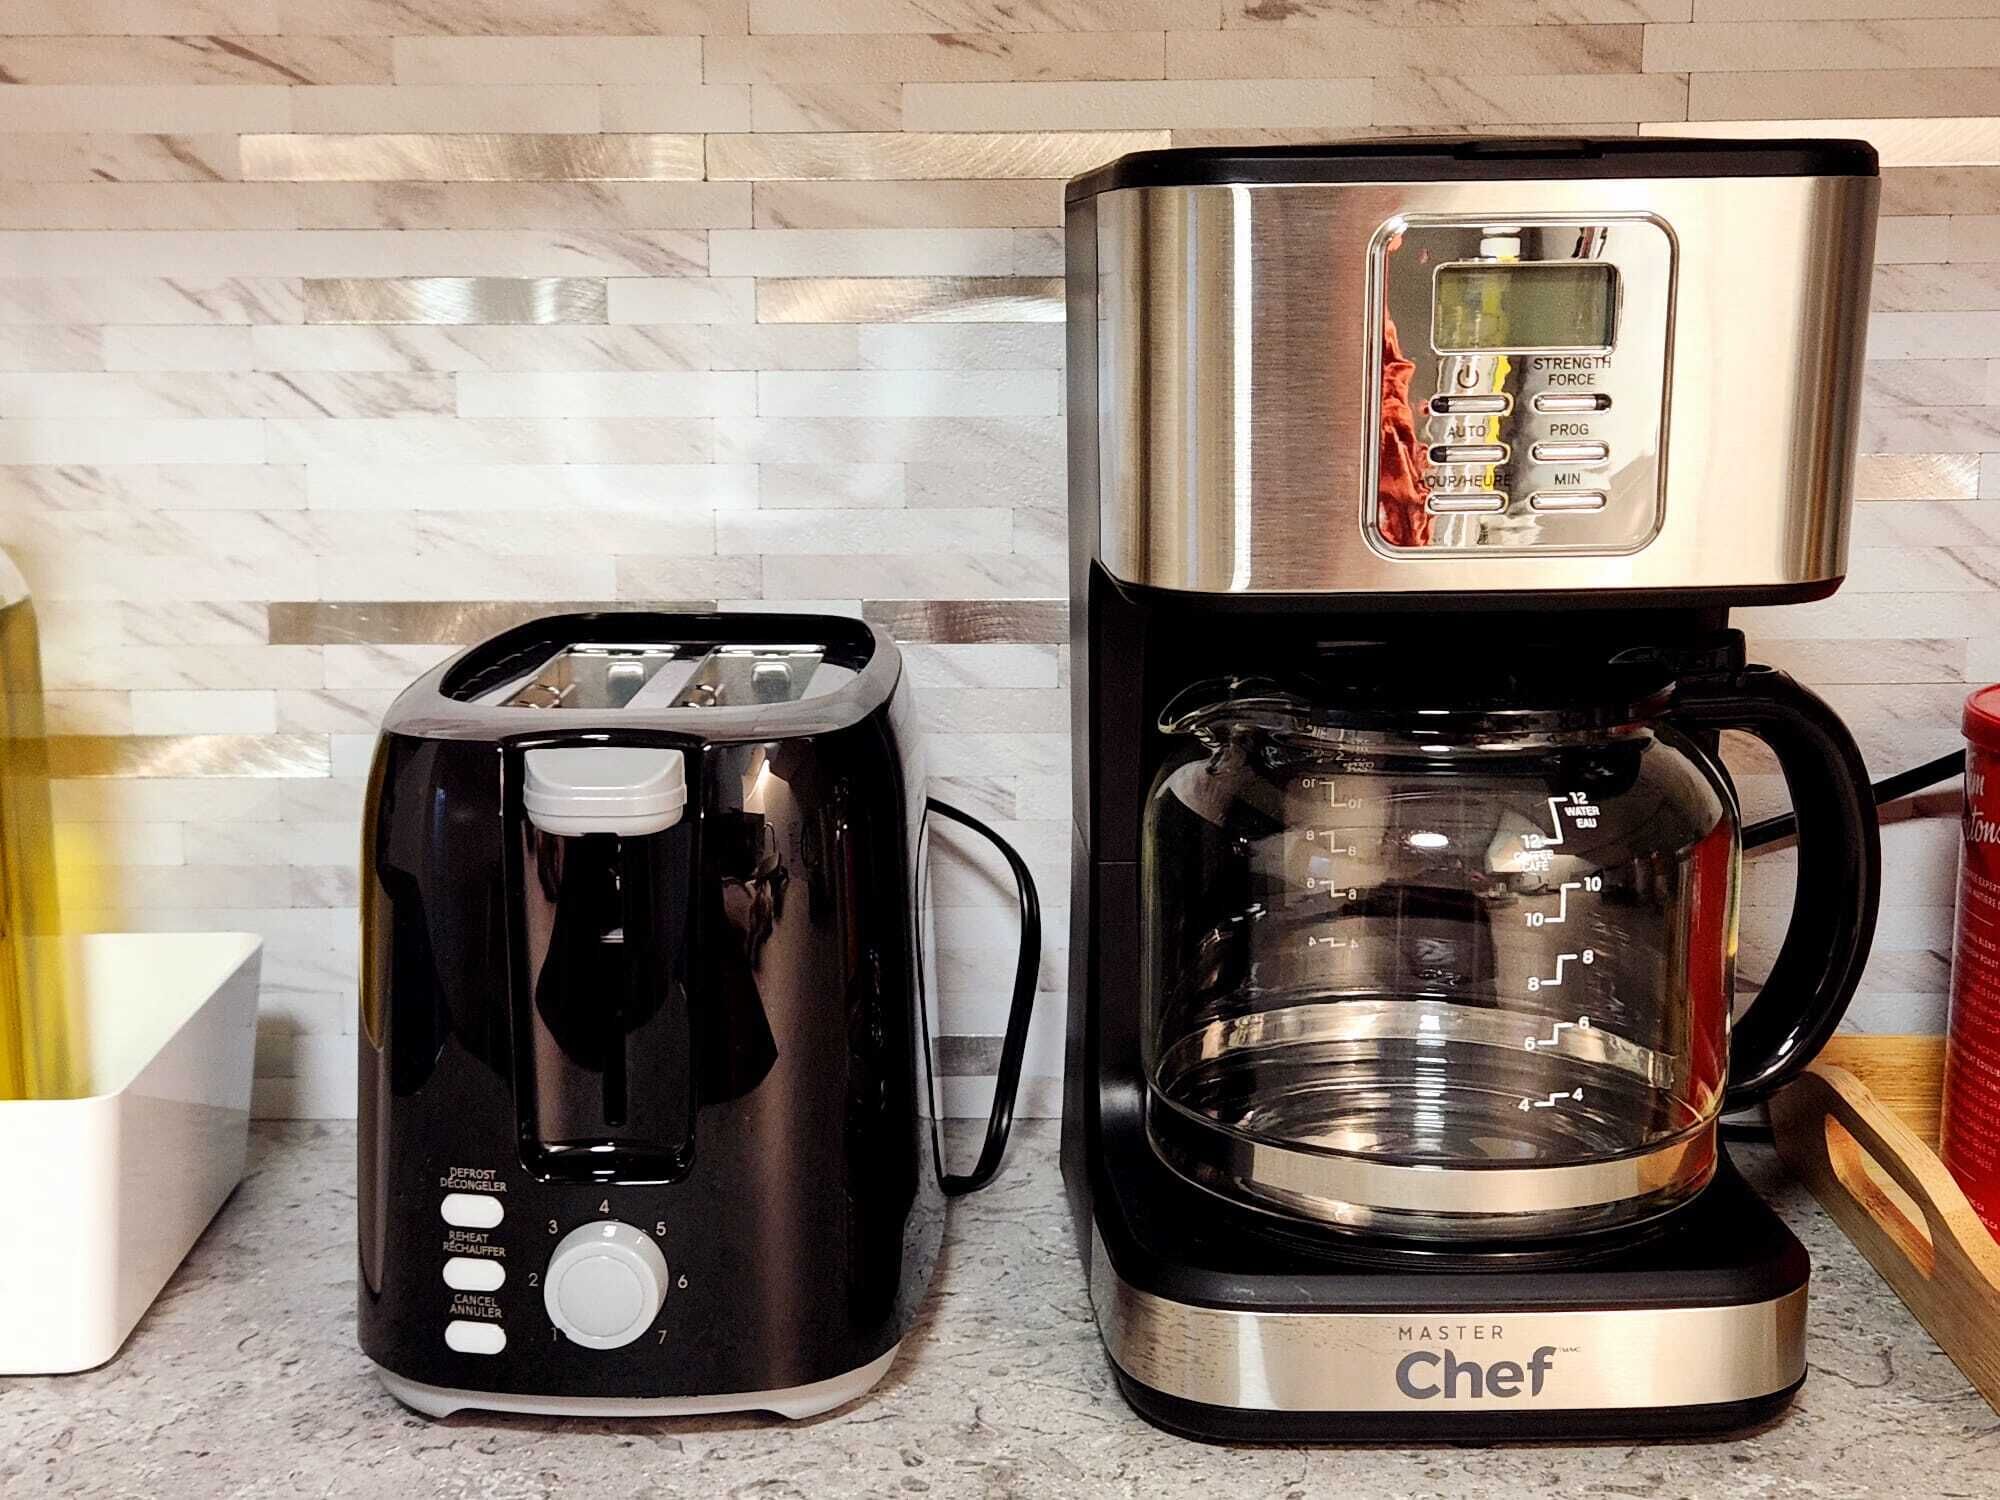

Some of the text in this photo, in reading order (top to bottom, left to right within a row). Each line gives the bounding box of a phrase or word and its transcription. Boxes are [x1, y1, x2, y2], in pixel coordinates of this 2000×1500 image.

[1534, 357, 1611, 370] STRENGTH
[1548, 374, 1596, 386] FORCE
[1448, 426, 1485, 438] AUTO
[1550, 424, 1589, 436] PROG
[1418, 474, 1512, 488] OUR/HEURE
[1554, 474, 1581, 485] MIN
[1569, 792, 1588, 805] 12
[1564, 806, 1600, 817] WATER
[1576, 818, 1597, 829] EAU
[1521, 834, 1545, 849] 12
[1584, 877, 1602, 892] 10
[1525, 912, 1544, 927] 10
[1582, 949, 1594, 965] 8
[1527, 977, 1540, 991] 8
[1578, 1016, 1590, 1030] 6
[1524, 1036, 1536, 1050] 6
[1571, 1087, 1584, 1102] 4
[1518, 1098, 1531, 1112] 4
[449, 1167, 496, 1180] DEFROST
[440, 1177, 507, 1192] DÉCONGELER
[599, 1199, 610, 1214] 4
[548, 1220, 559, 1235] 3
[655, 1222, 667, 1237] 5
[448, 1230, 489, 1243] REHEAT
[443, 1240, 506, 1257] RÉCHAUFFER
[528, 1272, 539, 1288] 2
[677, 1273, 689, 1289] 6
[454, 1294, 498, 1307] CANCEL
[449, 1304, 503, 1319] ANNULER
[657, 1330, 668, 1345] 7
[1399, 1325, 1504, 1341] MASTER
[1396, 1345, 1557, 1400] Chef
